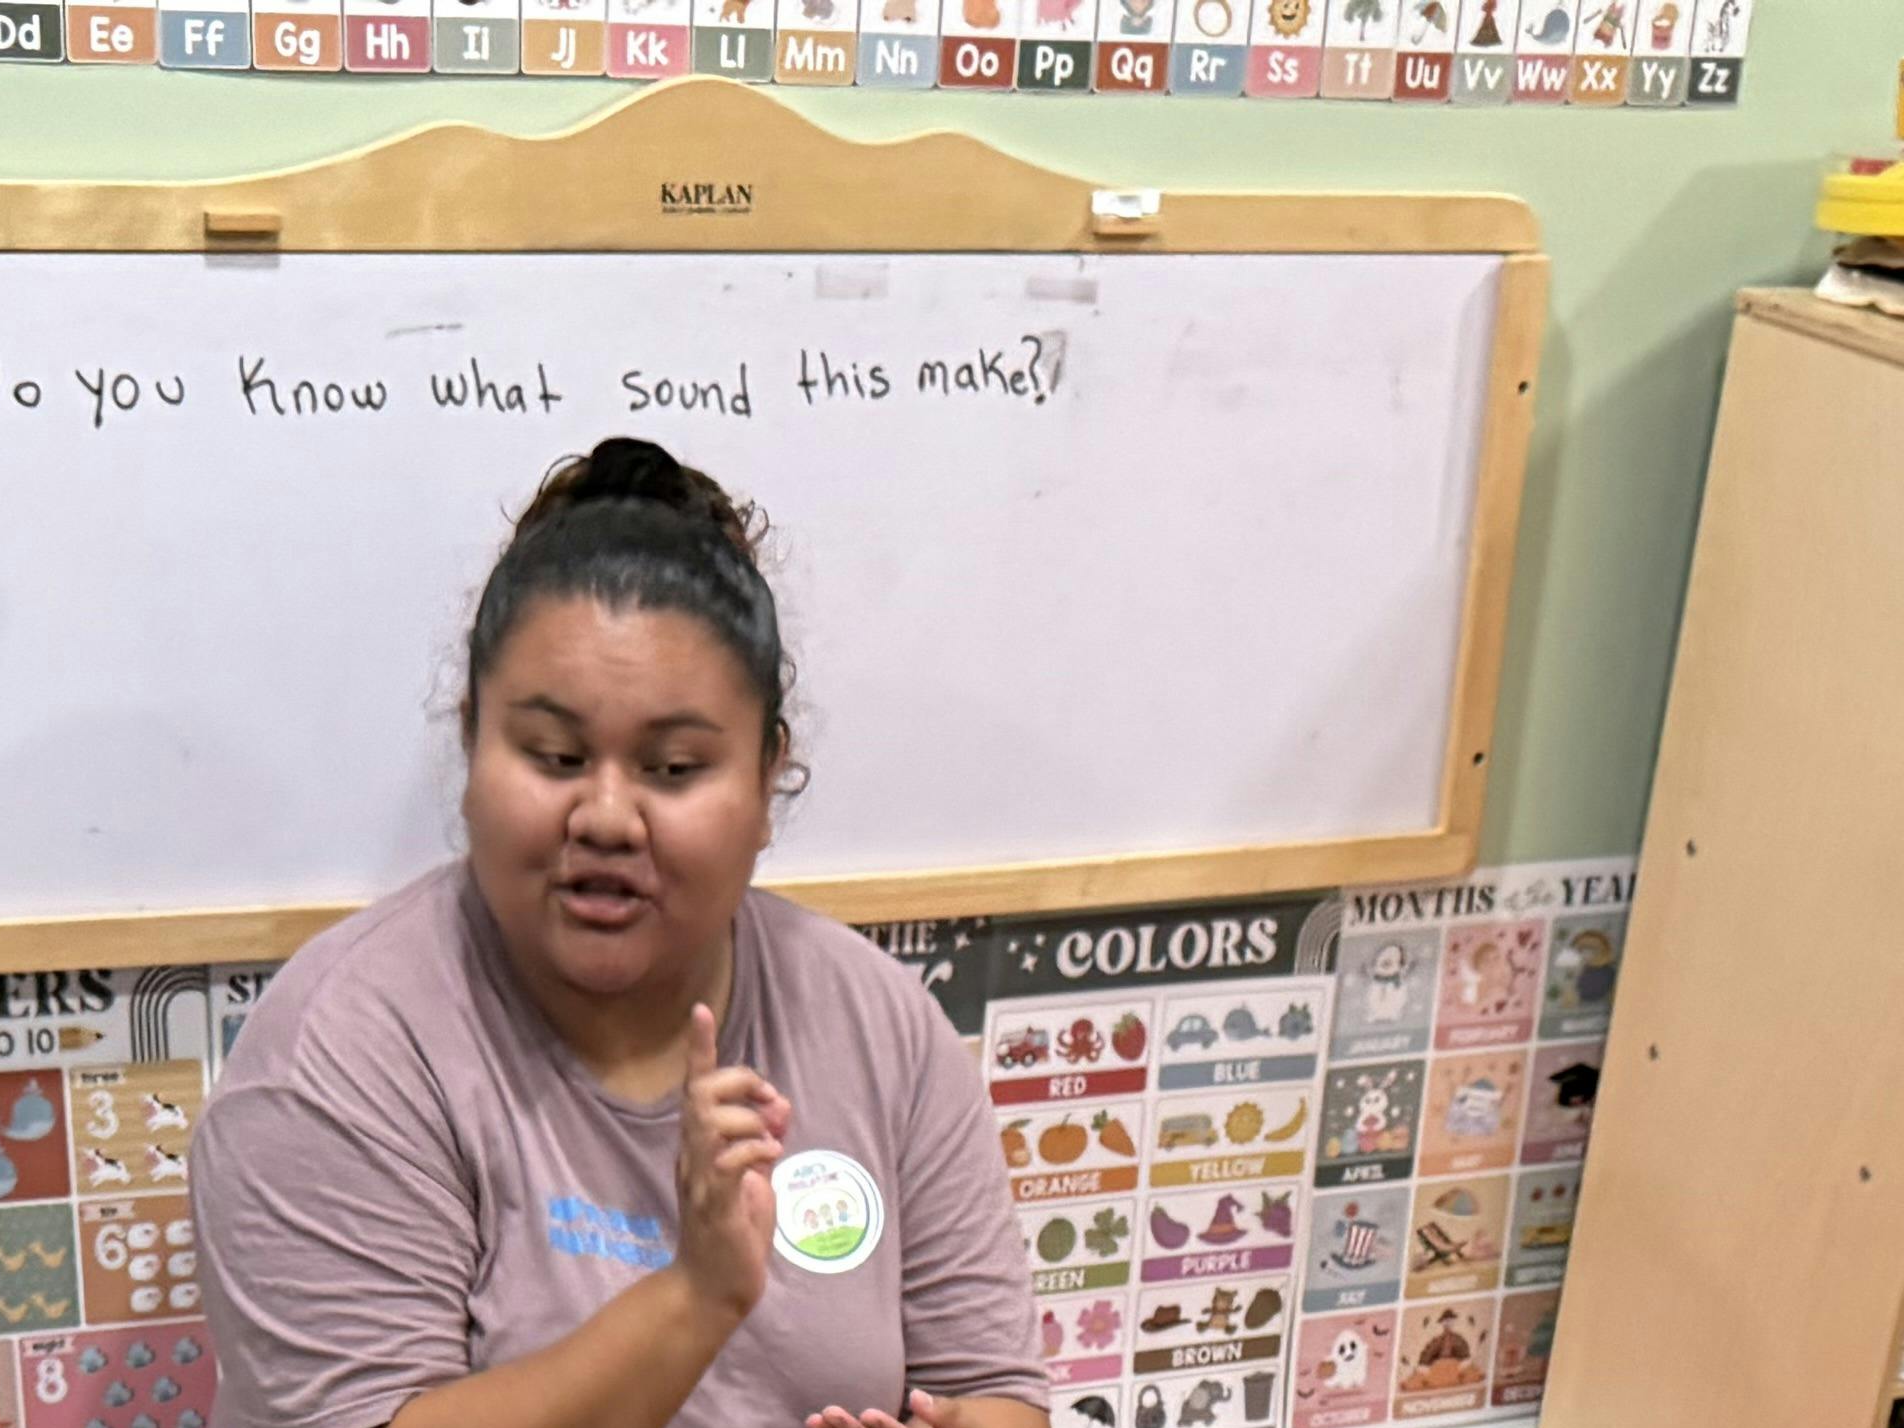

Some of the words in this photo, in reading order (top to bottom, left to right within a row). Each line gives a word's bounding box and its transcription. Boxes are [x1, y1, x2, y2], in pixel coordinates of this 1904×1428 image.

[89, 16, 135, 54] Ee
[184, 18, 225, 56] Ff
[274, 20, 322, 65] Gg
[365, 23, 410, 61] Hh
[625, 30, 670, 67] Kk
[784, 35, 846, 72] Mm
[874, 39, 919, 77] Nn
[955, 43, 1000, 78] Oo
[1034, 45, 1075, 87] Pp
[1111, 47, 1154, 88] Qq
[1189, 48, 1227, 83] Rr
[1266, 50, 1300, 84] Ss
[1404, 56, 1441, 90] Uu
[1463, 57, 1504, 91] Vv
[1517, 58, 1568, 92] Ww
[1580, 60, 1618, 93] Xx
[1641, 60, 1677, 100] Yy
[1697, 61, 1731, 95] Zz
[661, 183, 752, 205] KAPLAN
[75, 367, 186, 430] you
[432, 356, 563, 414] what
[797, 349, 892, 405] this
[1350, 885, 1497, 925] MONTHS
[1055, 917, 1279, 979] COLORS
[27, 1027, 55, 1056] 10
[1212, 1060, 1263, 1084] BLUE
[1047, 1076, 1087, 1099] RED
[85, 1089, 121, 1141] 3
[1188, 1155, 1267, 1181] YELLOW
[1018, 1171, 1103, 1199] ORANGE
[94, 1223, 129, 1271] 6
[1180, 1251, 1253, 1273] PURPLE
[1033, 1267, 1087, 1292] REEN
[1171, 1343, 1243, 1368] BROWN
[35, 1357, 69, 1404] 8
